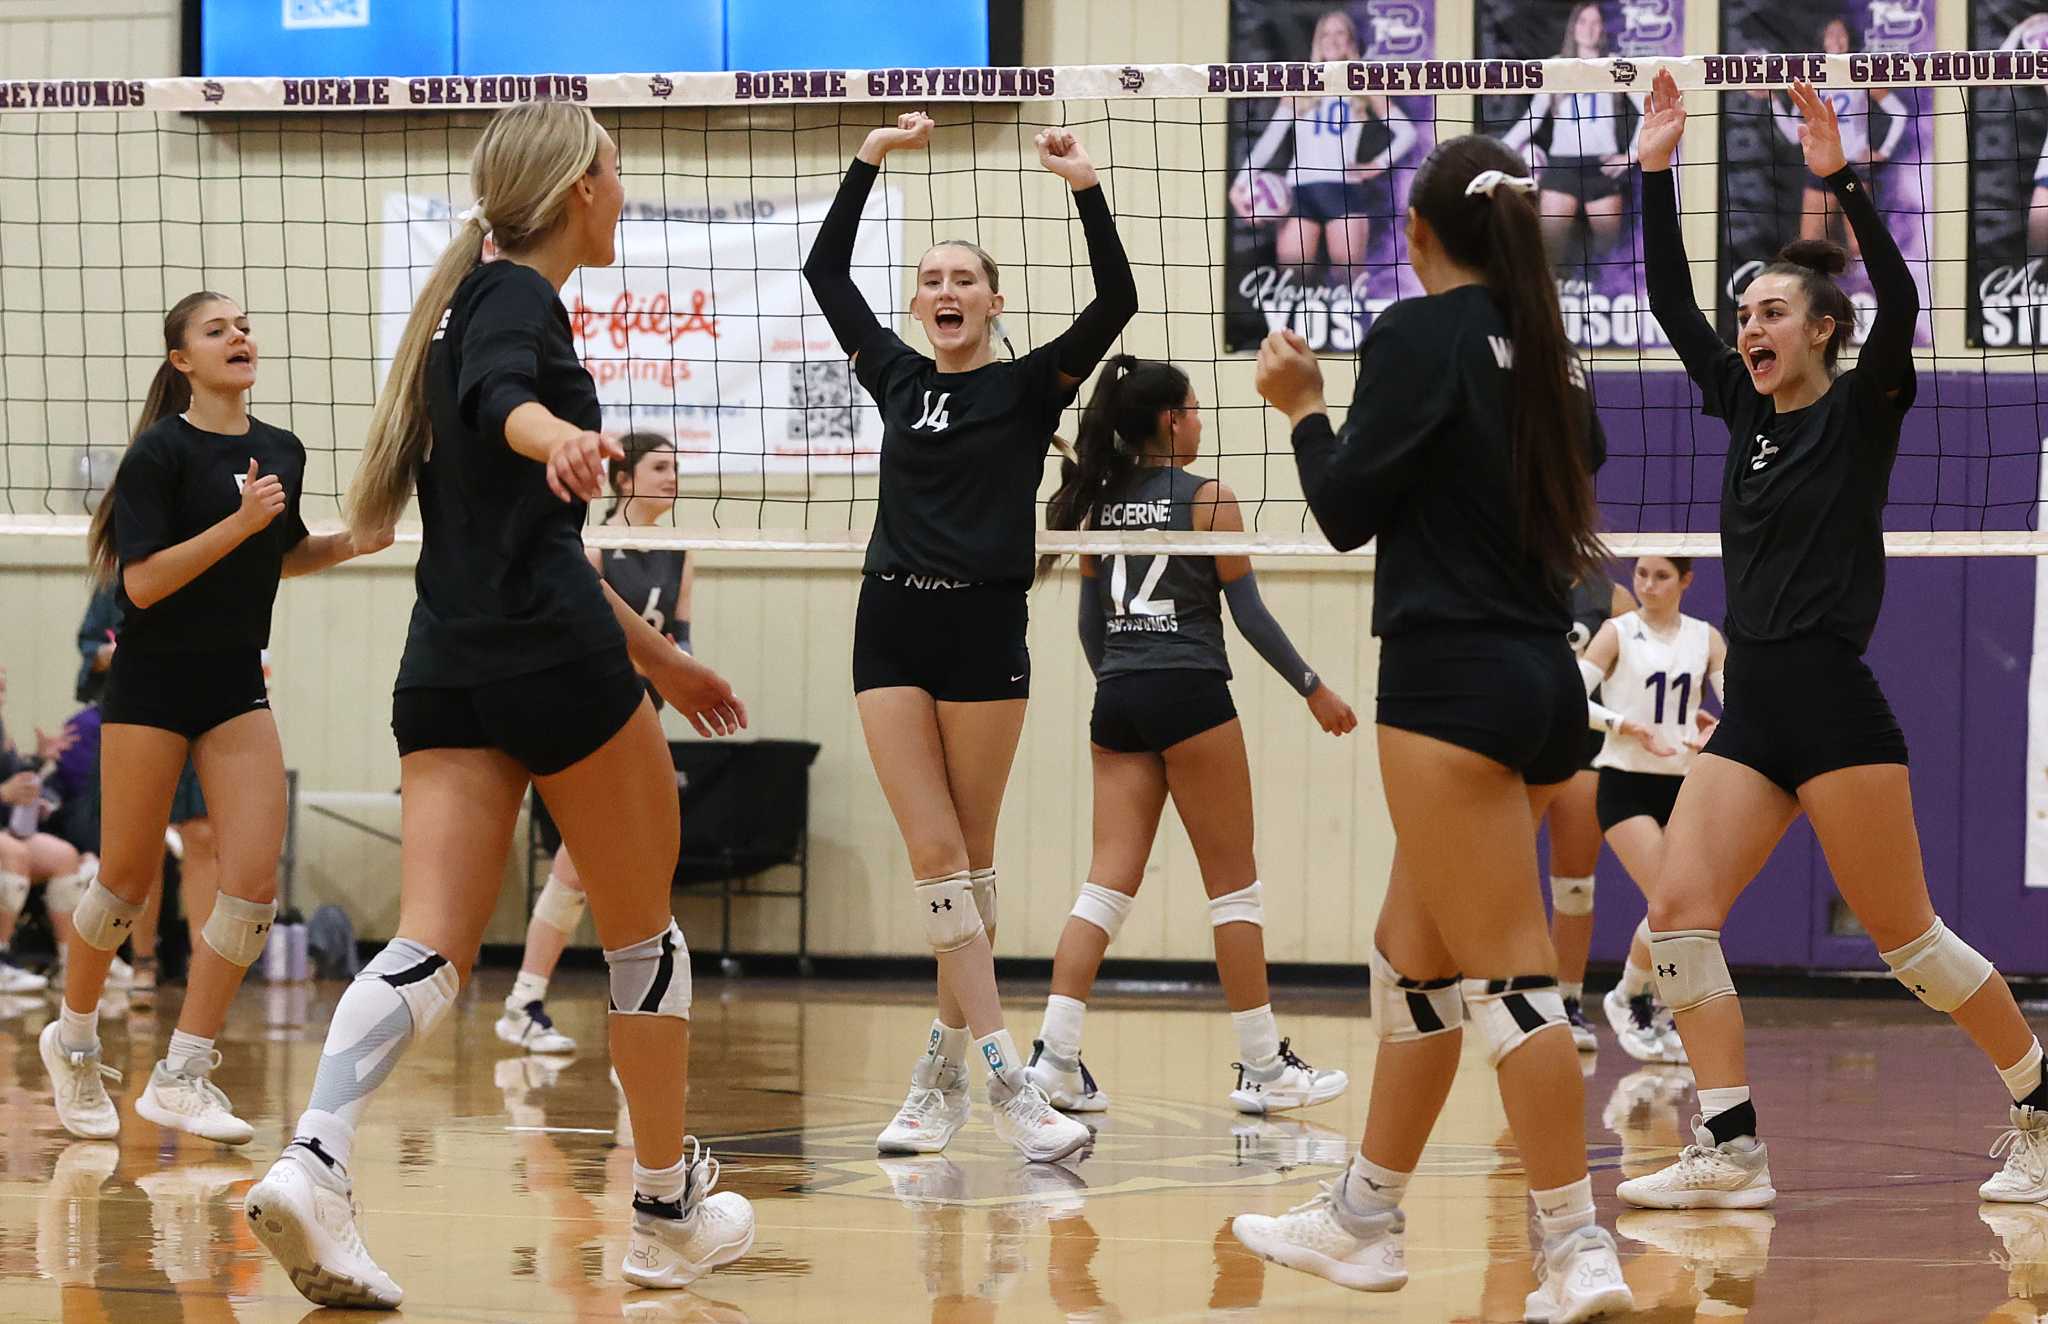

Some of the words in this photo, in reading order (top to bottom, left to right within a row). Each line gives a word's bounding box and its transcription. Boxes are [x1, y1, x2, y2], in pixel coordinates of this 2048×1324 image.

[1207, 63, 1325, 92] BOERNE
[1347, 61, 1544, 91] GREYHOUNDS
[1704, 54, 1827, 85] BOERNE
[1850, 50, 2048, 83] GREYHOUNDS
[283, 78, 389, 105] BOERNE
[409, 75, 588, 104] GREYHOUNDS
[735, 71, 846, 99] BOERNE
[867, 68, 1055, 97] GREYHOUNDS
[733, 200, 776, 219] ISD
[1238, 265, 1371, 306] Hannah
[911, 390, 951, 432] 14
[1100, 498, 1172, 527] BOERNE
[1645, 671, 1692, 725] 11
